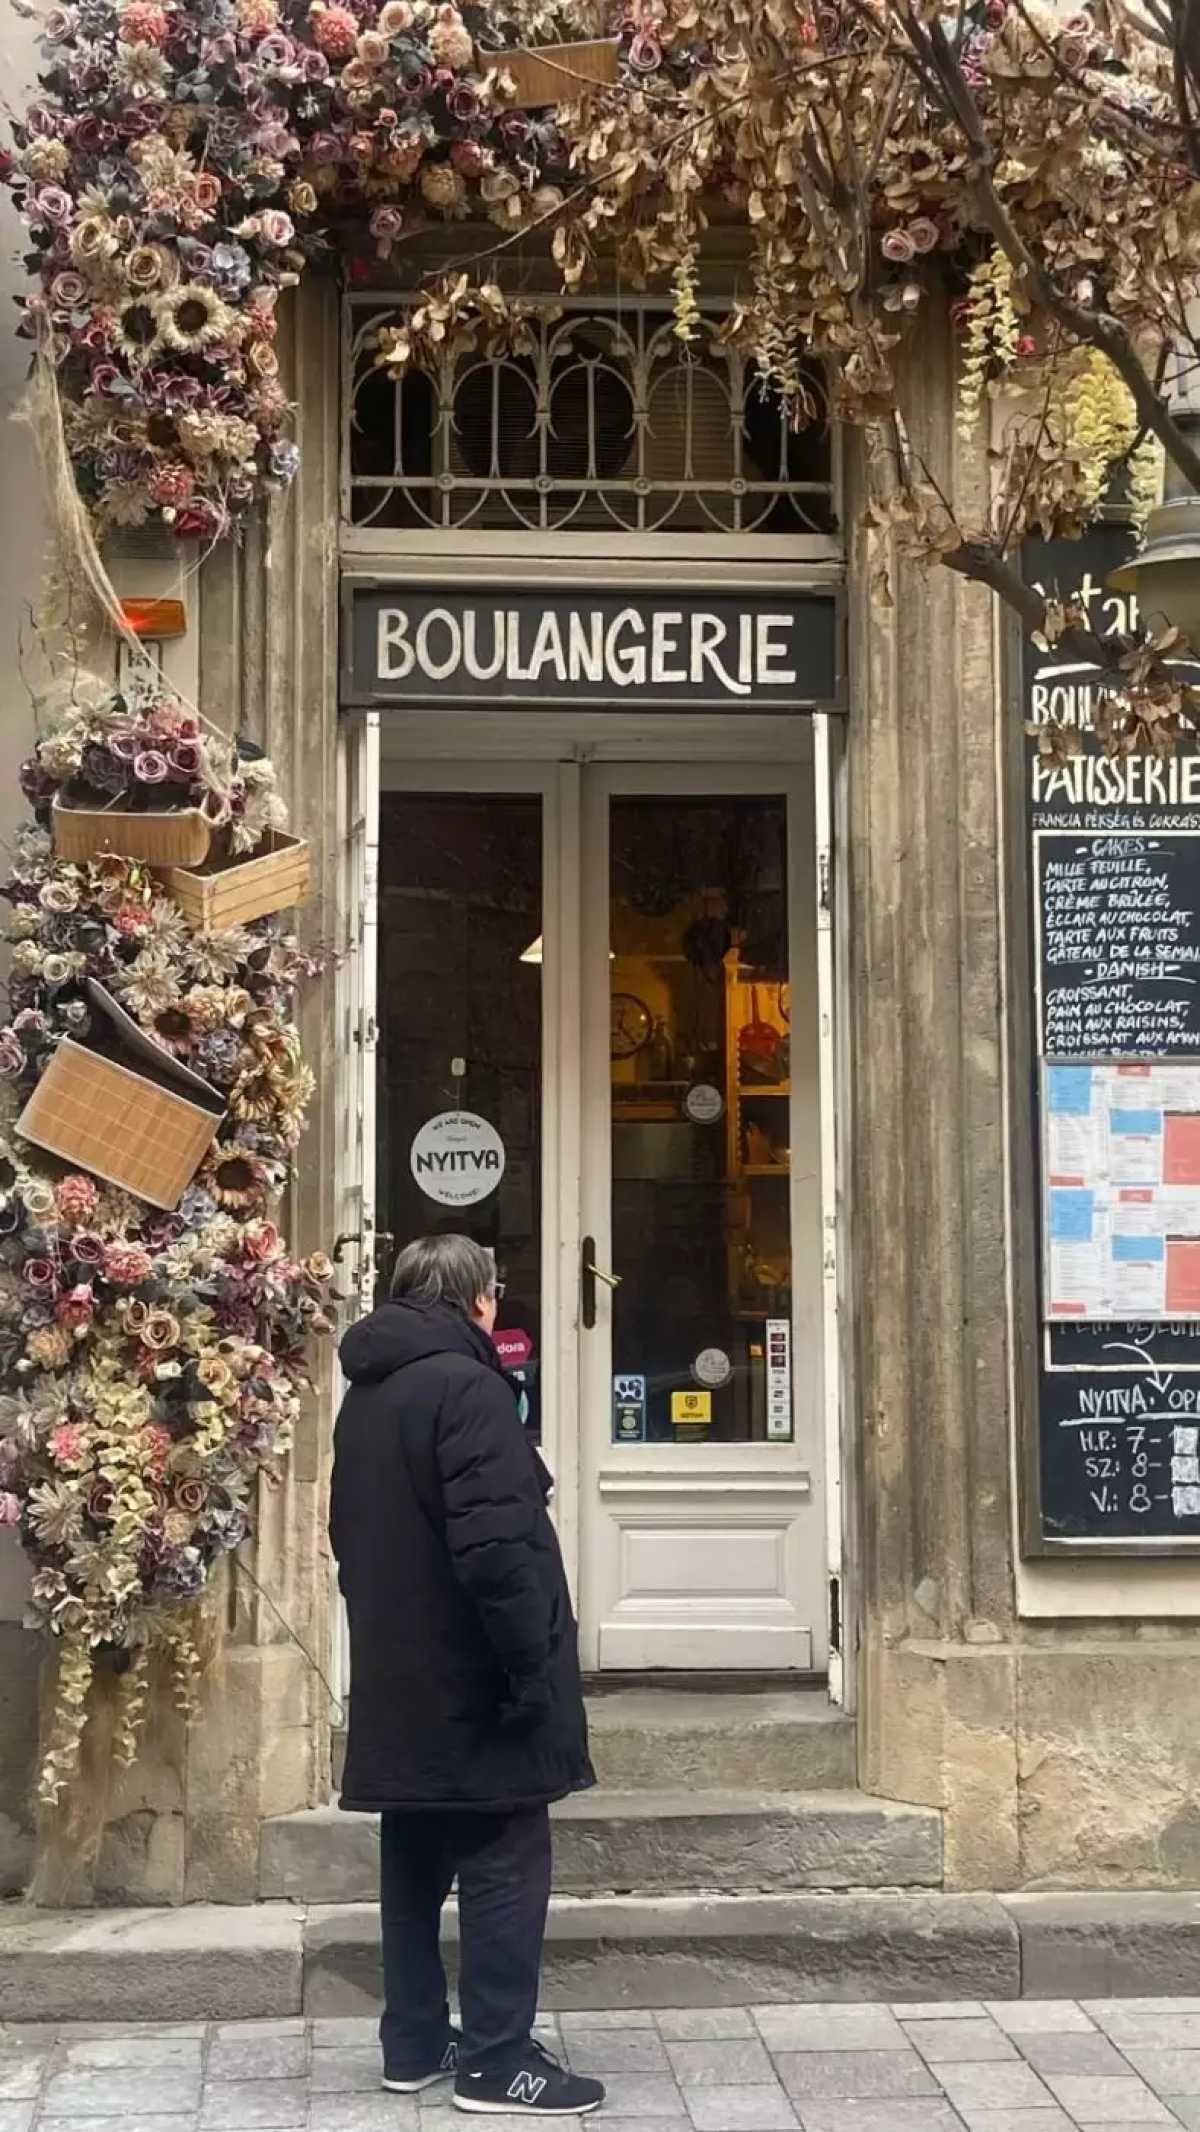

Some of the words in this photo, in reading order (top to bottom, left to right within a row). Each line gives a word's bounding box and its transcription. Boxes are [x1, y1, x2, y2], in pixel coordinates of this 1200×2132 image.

[377, 608, 797, 694] BOULANGERIE
[1032, 812, 1081, 828] FRANCIA
[1046, 862, 1086, 878] MILLE
[1043, 877, 1087, 893] TARTE
[1045, 893, 1101, 910] CRÈME
[1046, 928, 1092, 945] TARTE
[1095, 926, 1127, 943] AUX
[1130, 926, 1178, 942] FRUITS
[1110, 945, 1130, 959] DE
[1134, 945, 1152, 957] LA
[1047, 1004, 1082, 1019] PAIN
[1084, 1004, 1102, 1016] AU
[1047, 1020, 1082, 1037] PAIN
[1085, 1018, 1112, 1031] AUX
[1047, 1031, 1132, 1049] CROISSANT
[1136, 1031, 1164, 1046] AUX
[416, 1149, 499, 1173] NYITVA
